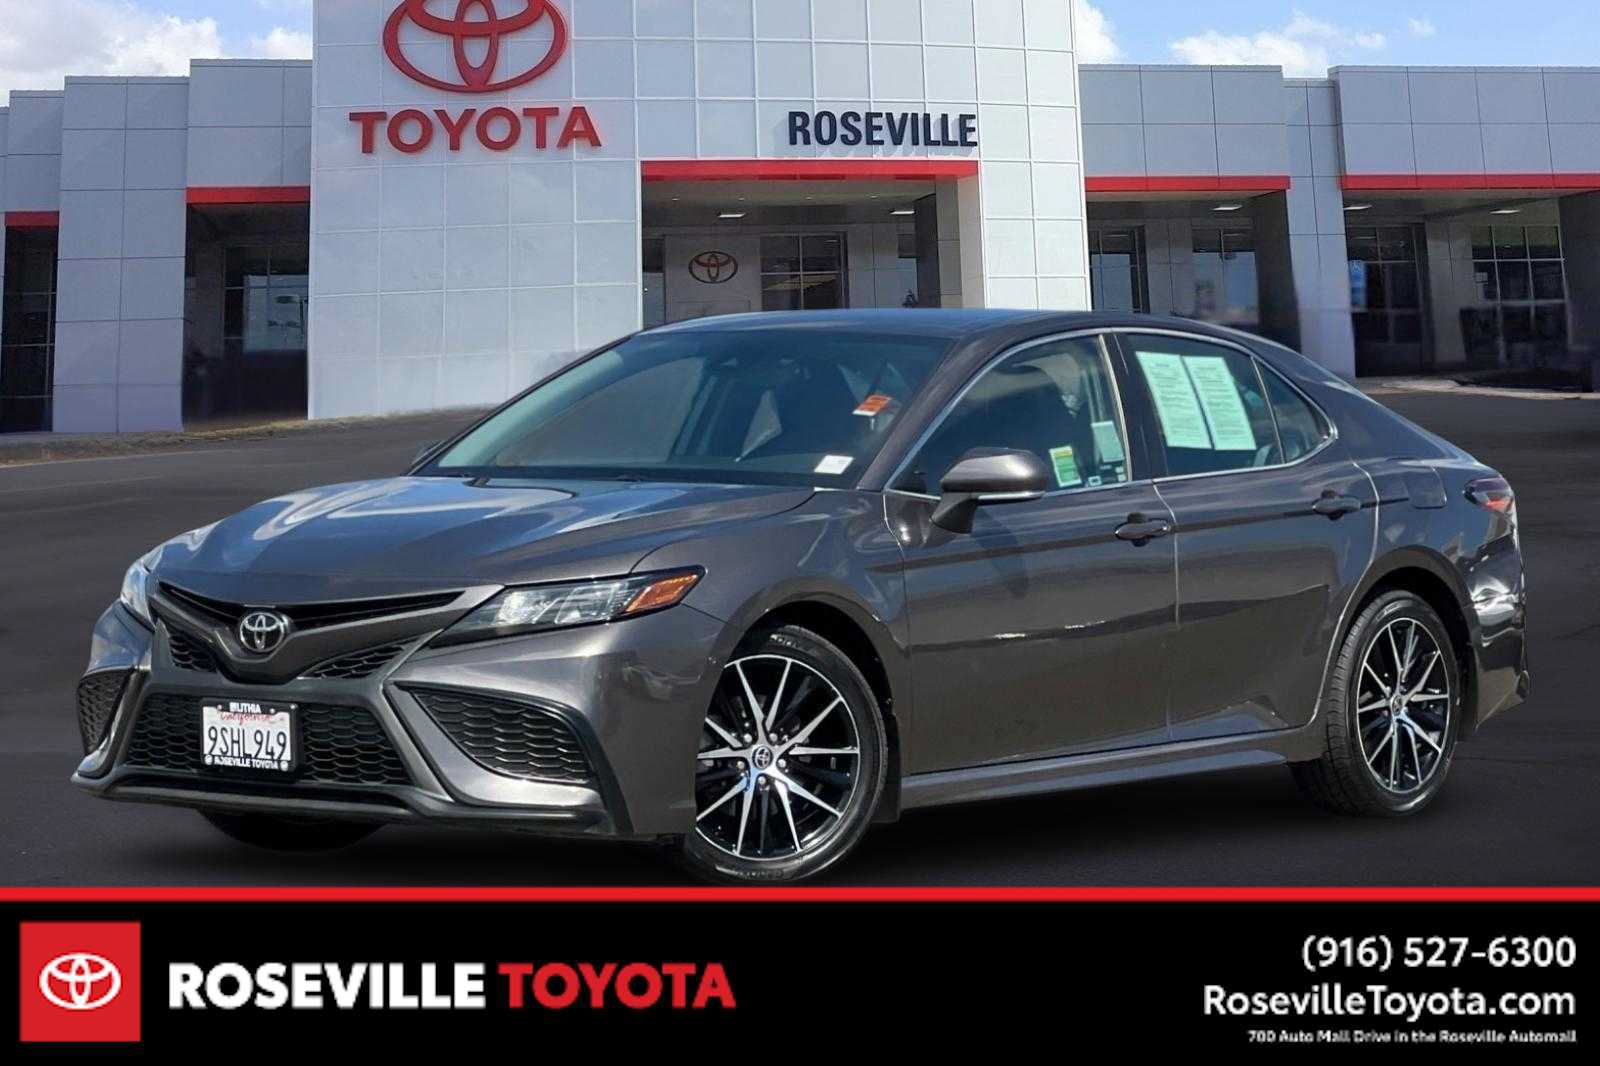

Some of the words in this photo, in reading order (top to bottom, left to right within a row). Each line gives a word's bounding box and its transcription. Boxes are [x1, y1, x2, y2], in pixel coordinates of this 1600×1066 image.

[349, 106, 602, 154] TOYOTA
[788, 110, 978, 147] ROSEVILLE
[251, 758, 279, 770] TOYOTA
